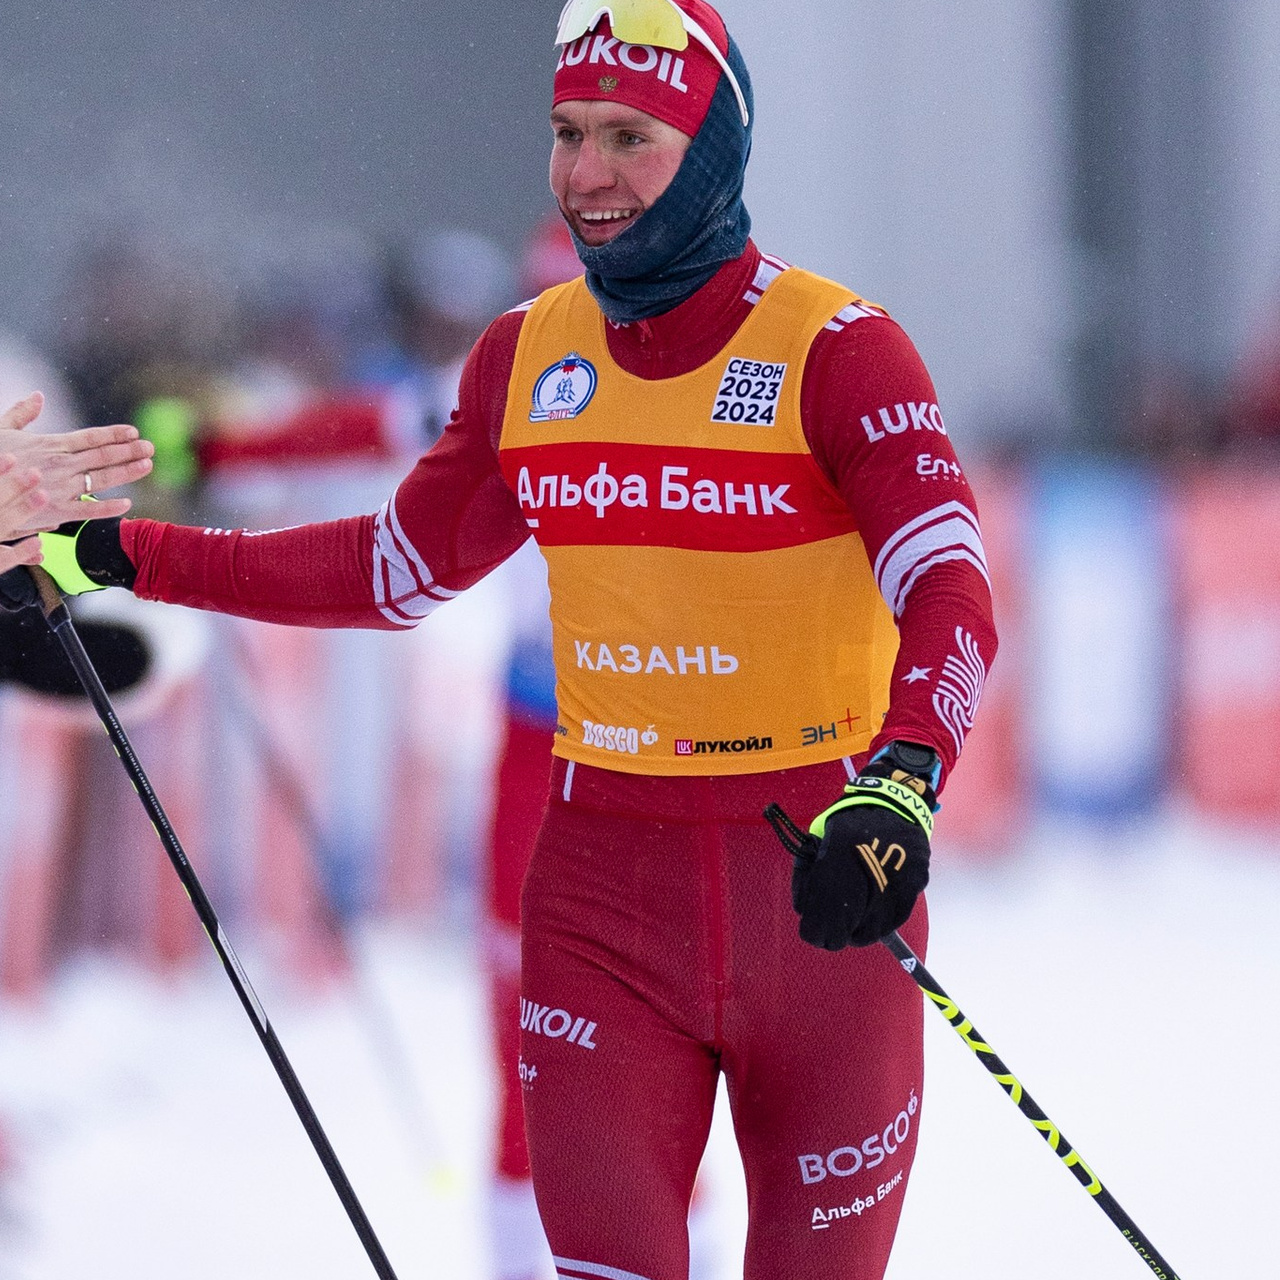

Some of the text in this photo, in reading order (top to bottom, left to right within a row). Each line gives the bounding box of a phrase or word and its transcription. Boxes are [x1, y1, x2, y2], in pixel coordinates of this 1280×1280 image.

[728, 359, 785, 380] СЕЗОН
[718, 376, 781, 402] 2023
[712, 400, 775, 425] 2024
[517, 462, 799, 519] Альфа Банк
[574, 640, 740, 676] КАЗАНЬ
[582, 720, 639, 755] BOSCO
[693, 737, 773, 754] ЛУКОЙЛ
[520, 996, 598, 1050] UKOIL
[798, 1111, 910, 1185] BOSCO
[811, 1170, 903, 1224] Альфа Банк
